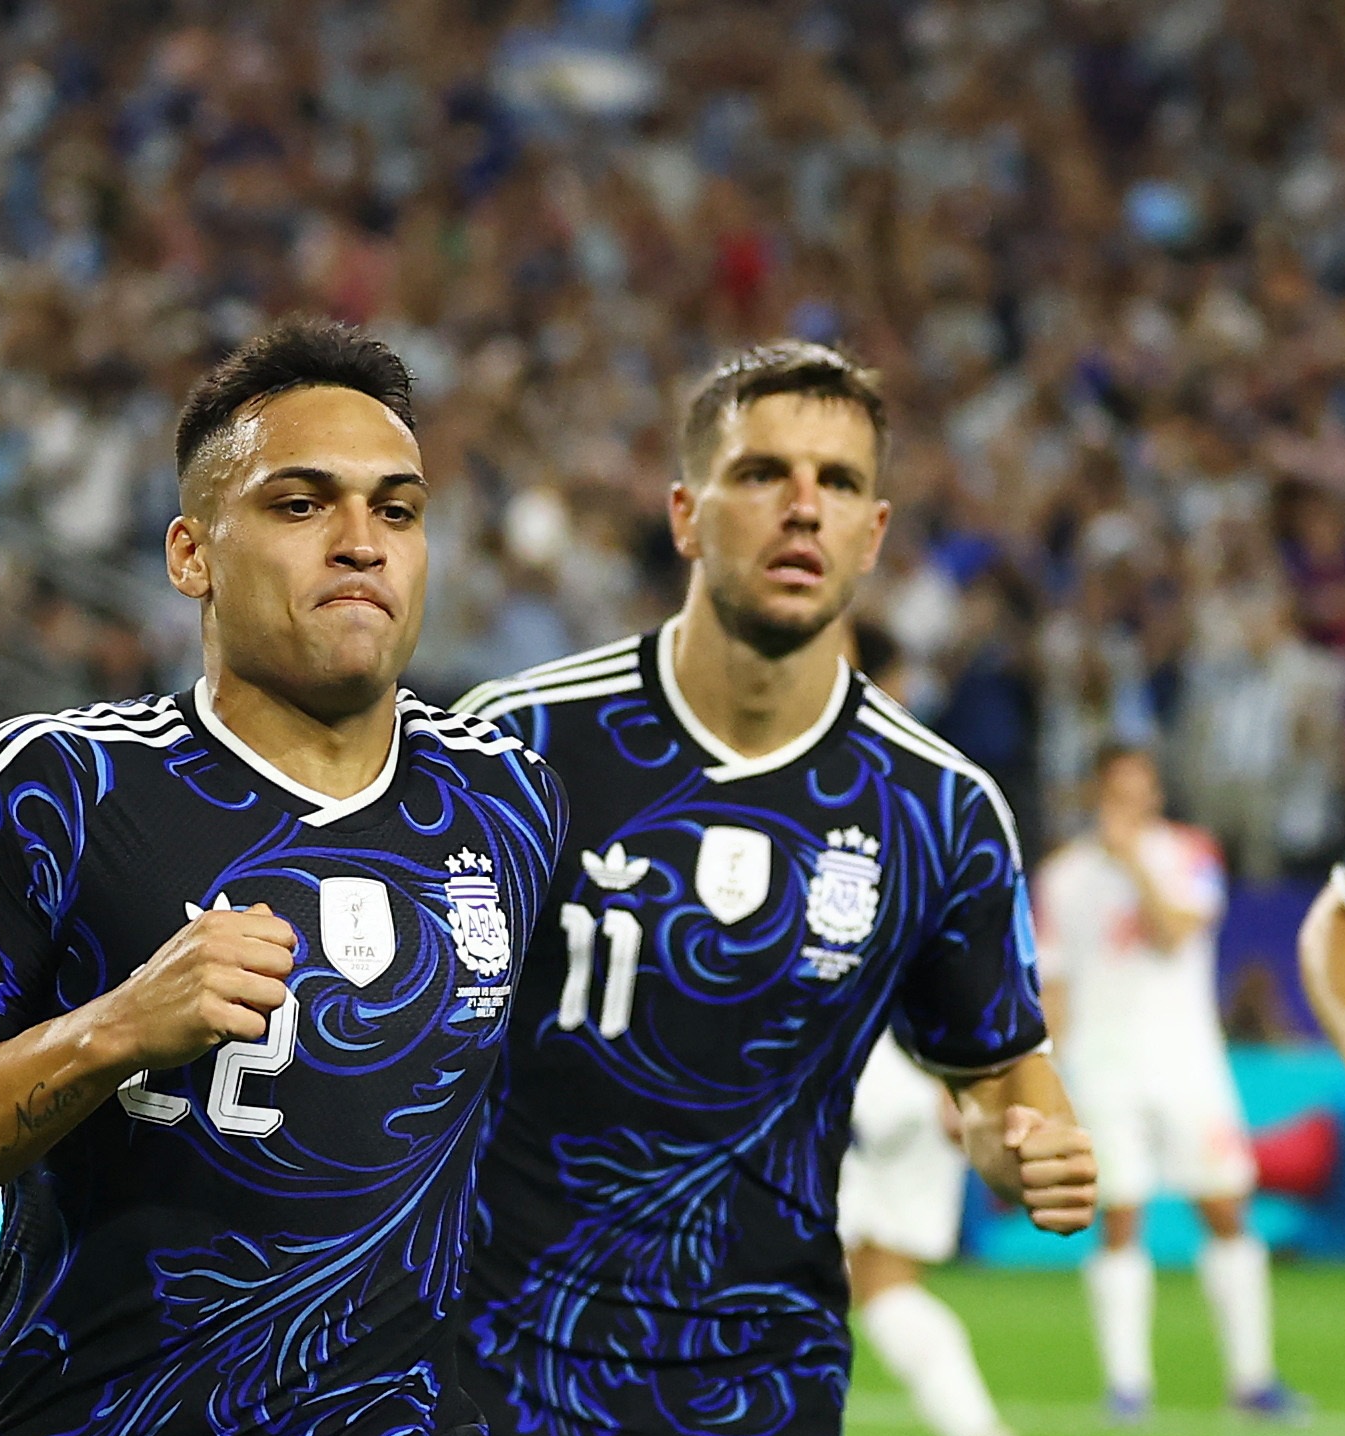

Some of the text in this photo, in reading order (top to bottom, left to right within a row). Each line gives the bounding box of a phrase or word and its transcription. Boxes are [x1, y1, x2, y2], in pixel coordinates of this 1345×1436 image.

[466, 903, 499, 946] AFA
[344, 945, 375, 957] FIFA
[557, 902, 643, 1040] 11
